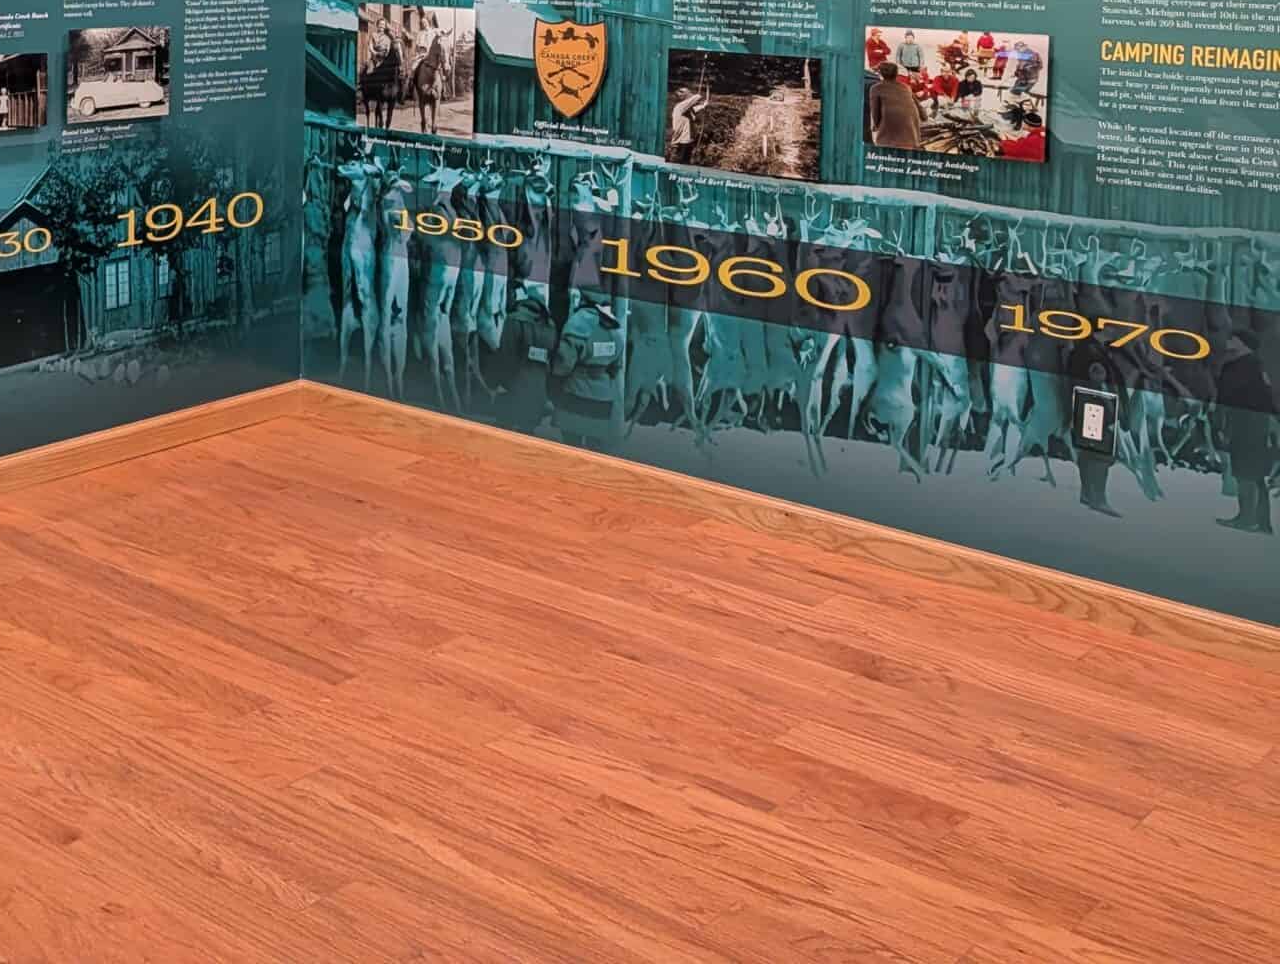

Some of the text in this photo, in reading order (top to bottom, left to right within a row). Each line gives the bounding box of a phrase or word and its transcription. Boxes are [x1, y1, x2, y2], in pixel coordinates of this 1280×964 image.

[1103, 41, 1186, 65] CAMPING
[116, 191, 265, 248] 1940
[393, 207, 525, 250] 1950
[600, 237, 872, 311] 1960
[1000, 303, 1211, 361] 1970
